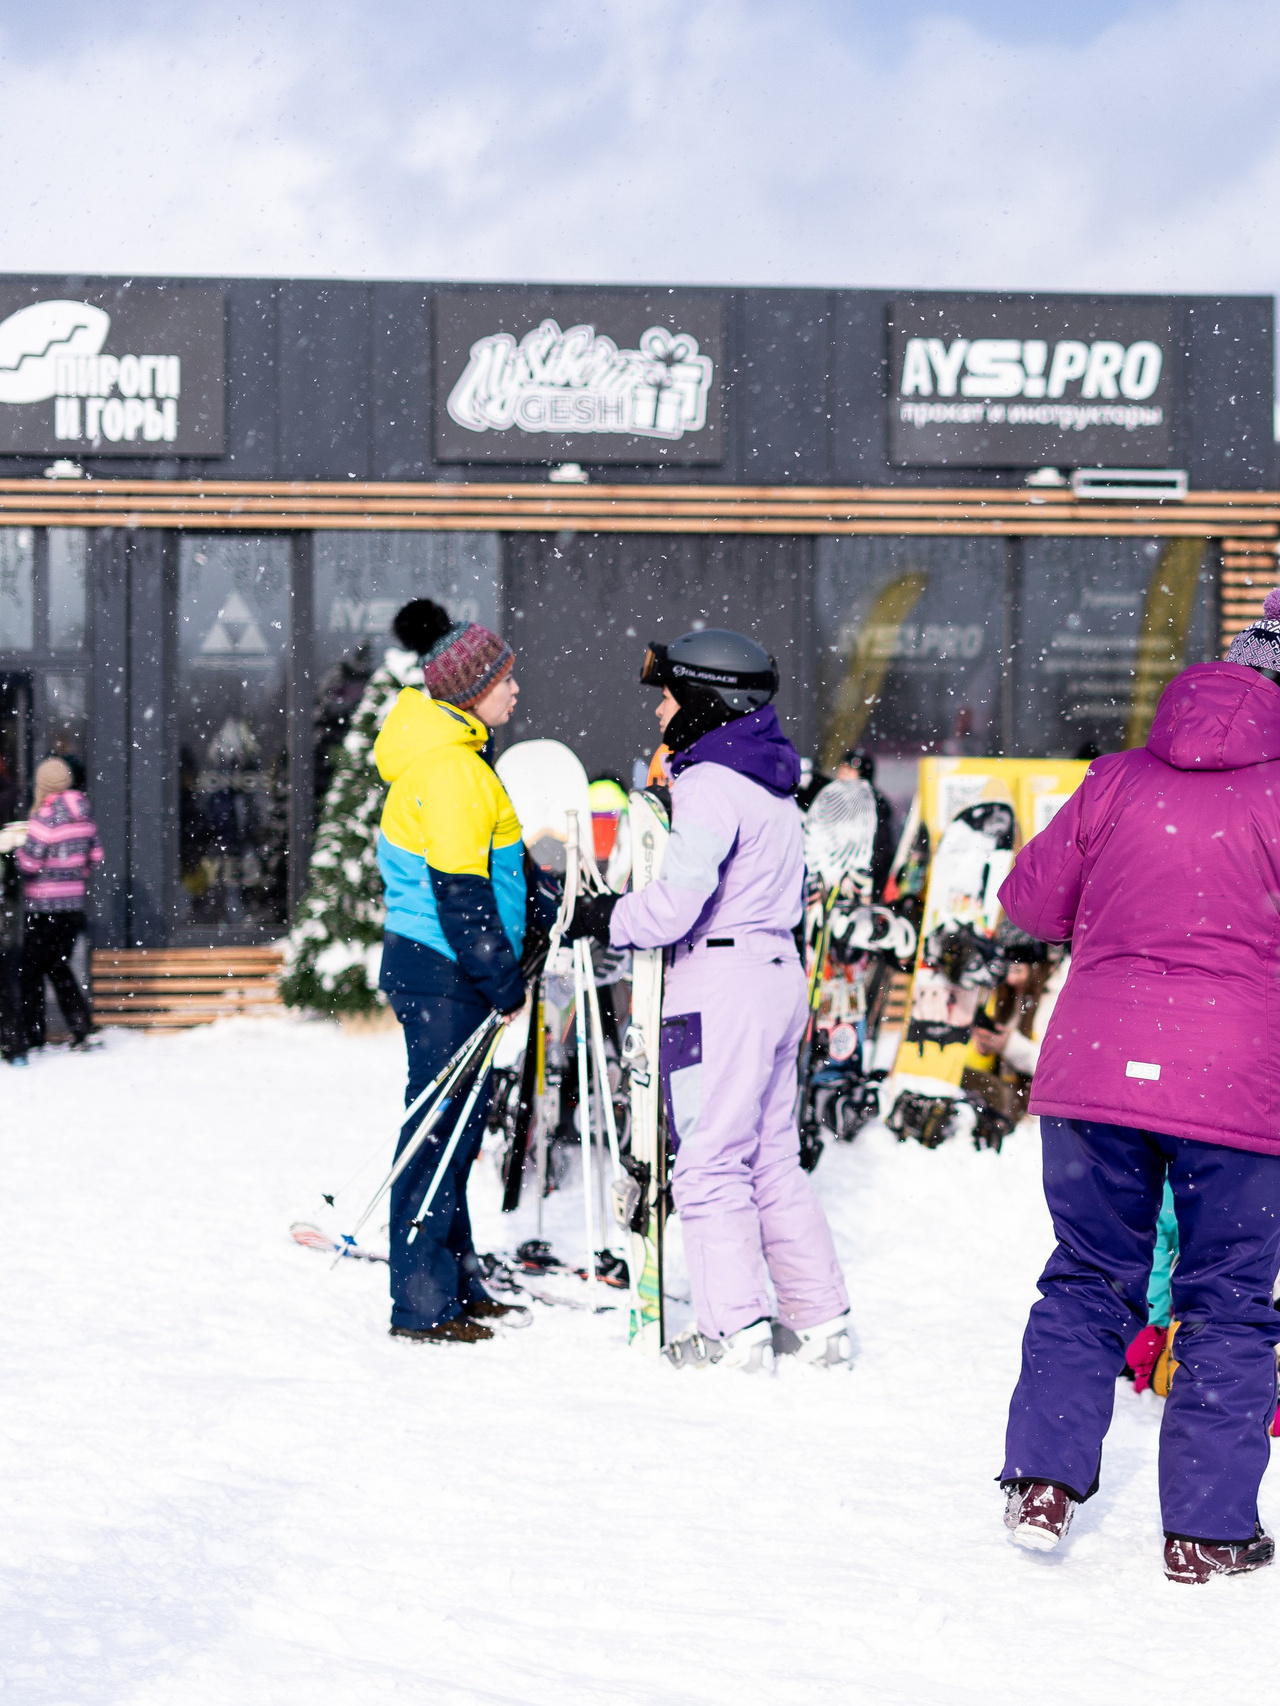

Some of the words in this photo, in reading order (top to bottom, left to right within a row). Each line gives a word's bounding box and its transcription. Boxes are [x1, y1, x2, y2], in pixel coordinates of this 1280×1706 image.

[55, 353, 181, 398] ПИРОГИ
[54, 397, 81, 440] И
[85, 397, 178, 441] ГОРЫ
